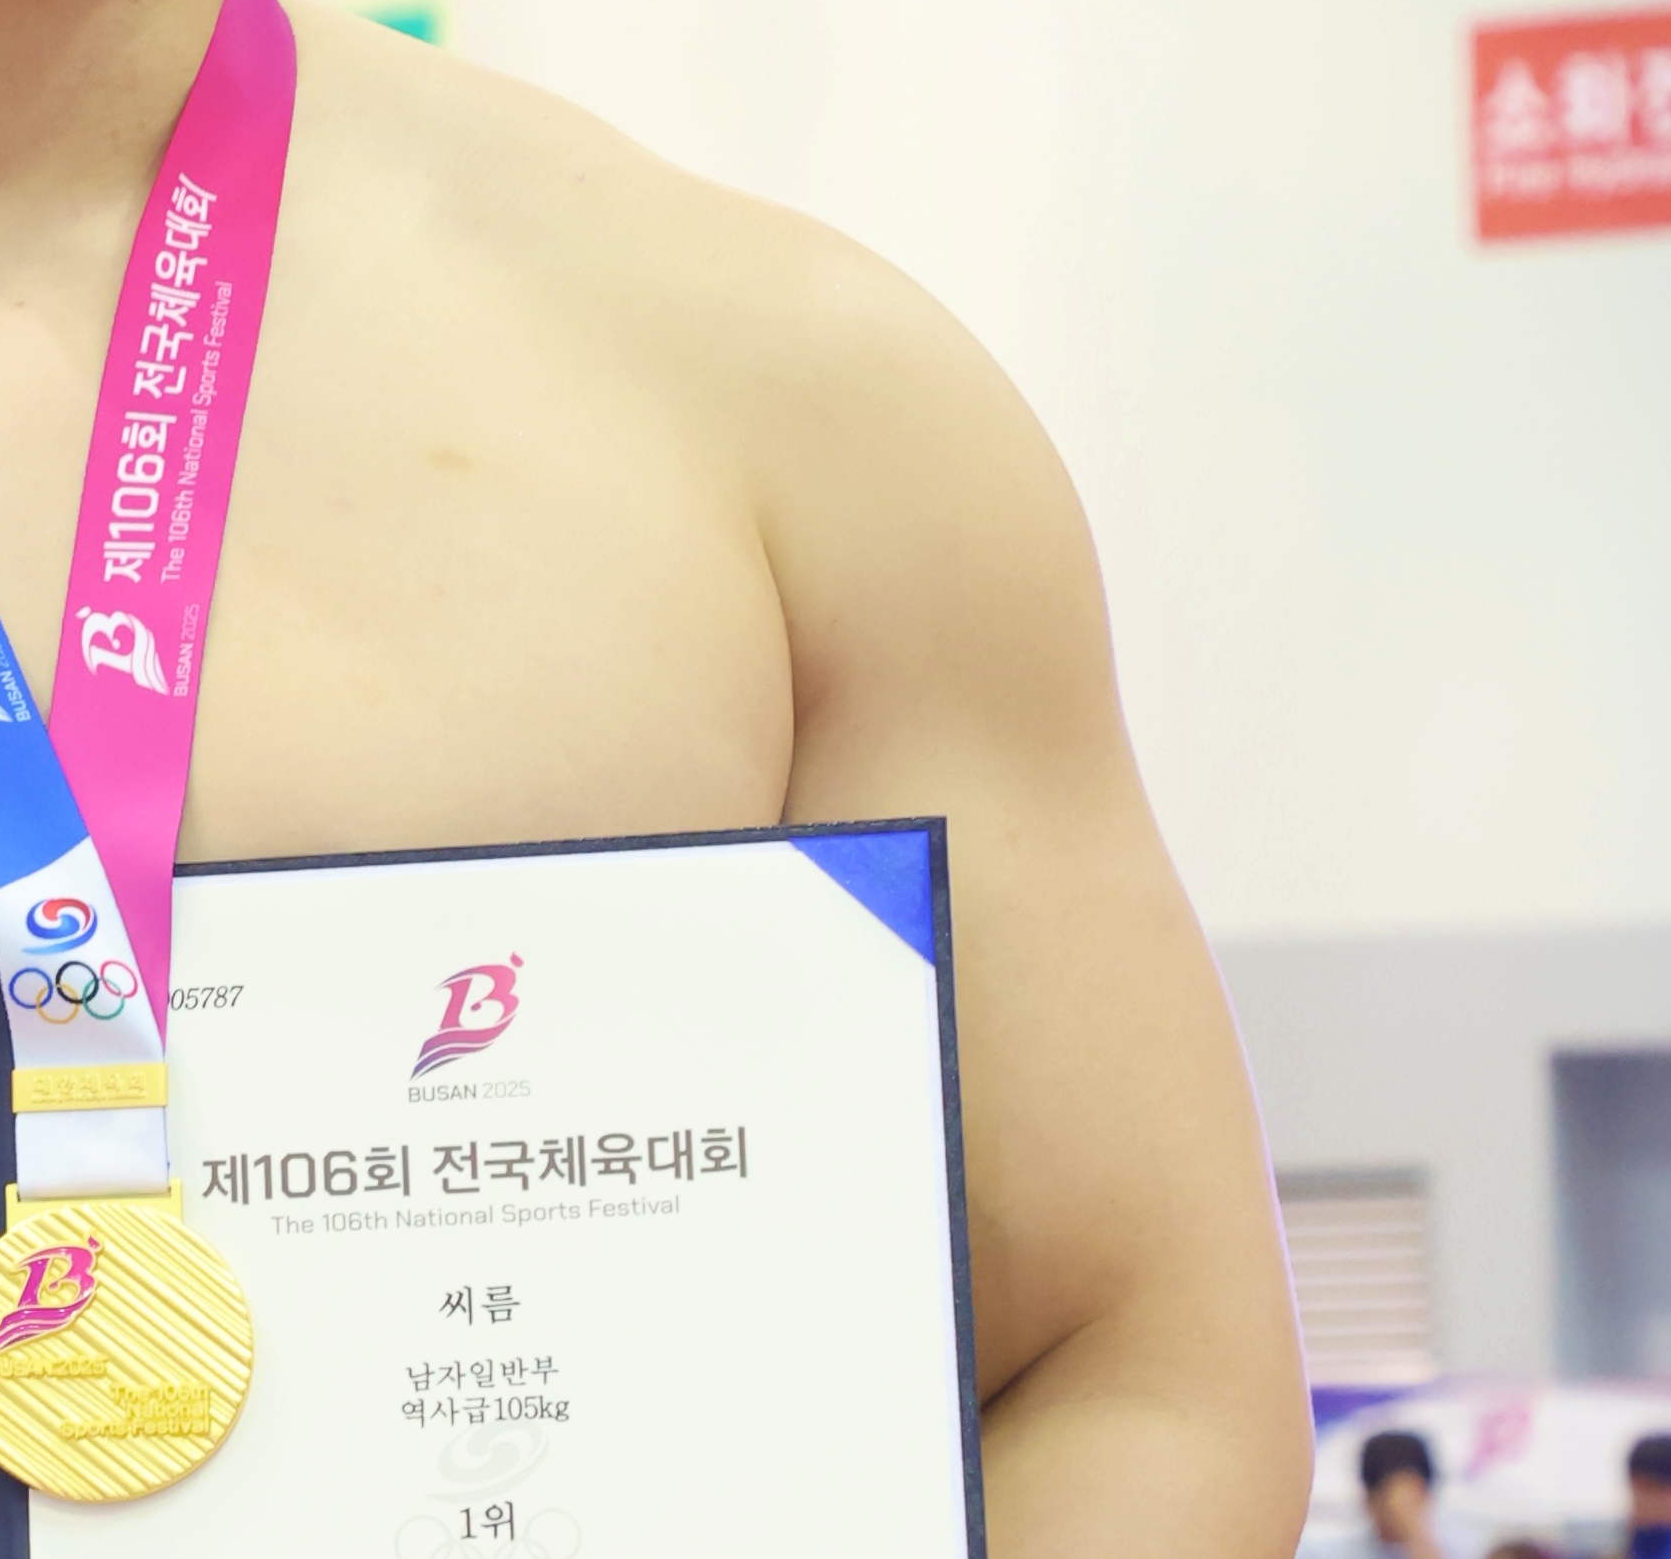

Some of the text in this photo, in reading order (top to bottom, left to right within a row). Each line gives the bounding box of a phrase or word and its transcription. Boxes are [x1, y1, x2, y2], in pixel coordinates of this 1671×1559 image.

[103, 172, 217, 584] 제106회 전국체육대회
[161, 281, 233, 584] The 106th National Sports Festival
[174, 642, 194, 697] BUSAN
[166, 984, 245, 1012] 05787
[408, 1079, 532, 1103] BUSAN 2025
[201, 1125, 749, 1206] 제106회 전국체육대회
[271, 1194, 681, 1235] The 106th National Sports Festival
[438, 1284, 522, 1327] 씨름
[405, 1355, 560, 1394] 남자일반부
[401, 1395, 570, 1429] 역사급105kg
[459, 1500, 516, 1542] 1위
